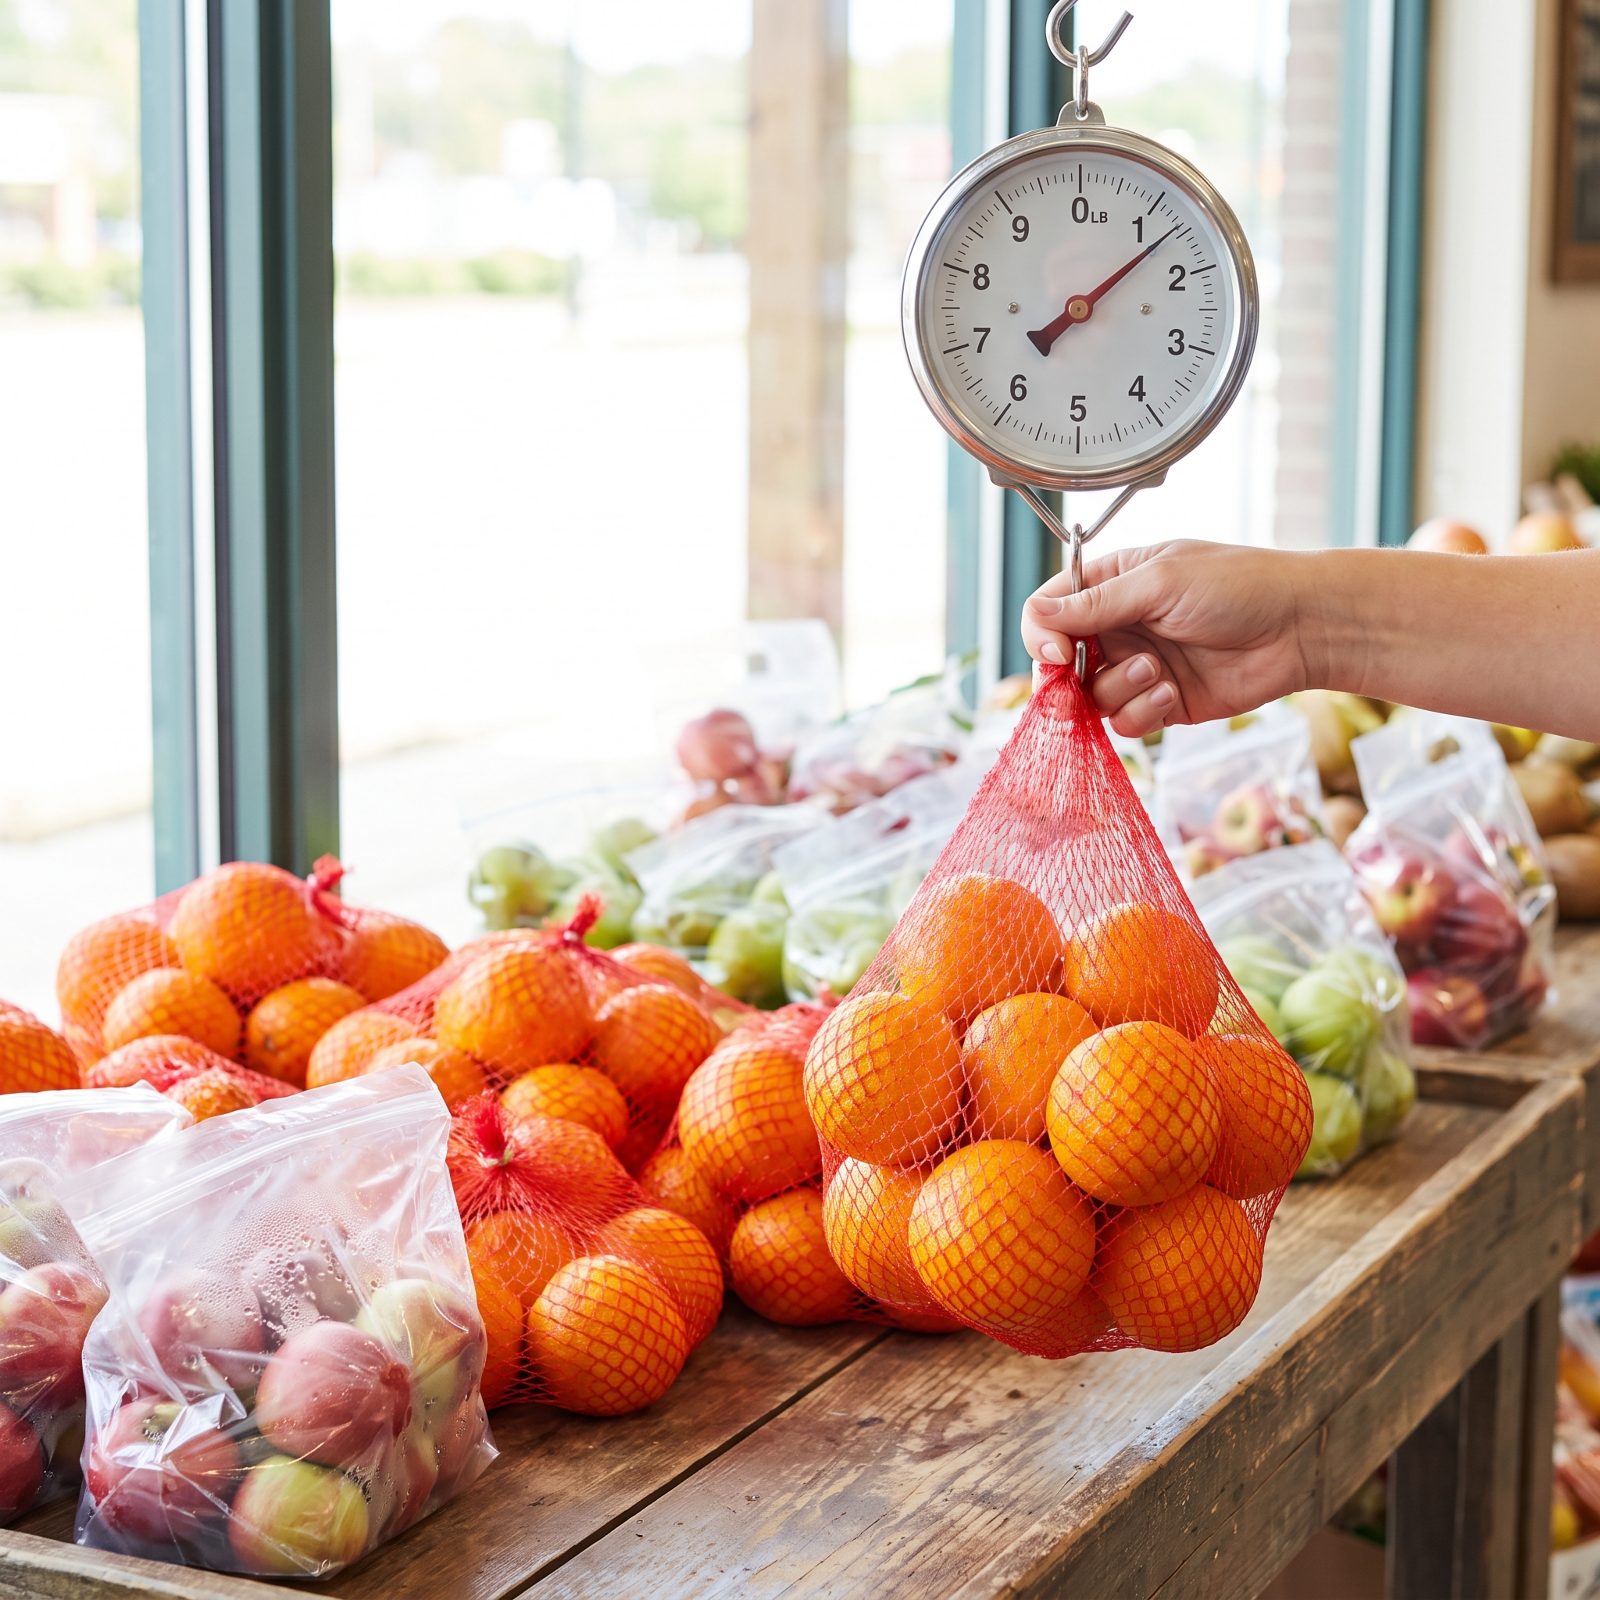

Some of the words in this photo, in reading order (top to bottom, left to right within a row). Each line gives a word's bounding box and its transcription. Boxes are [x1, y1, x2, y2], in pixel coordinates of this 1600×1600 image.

[1012, 215, 1029, 242] 9
[1091, 212, 1108, 223] LB
[1132, 216, 1142, 243] 1
[973, 264, 990, 290] 8
[1169, 265, 1185, 291] 2
[973, 328, 991, 353] 7
[1168, 329, 1184, 355] 3
[1010, 374, 1027, 401] 6
[1128, 376, 1146, 402] 4
[1070, 396, 1086, 422] 5
